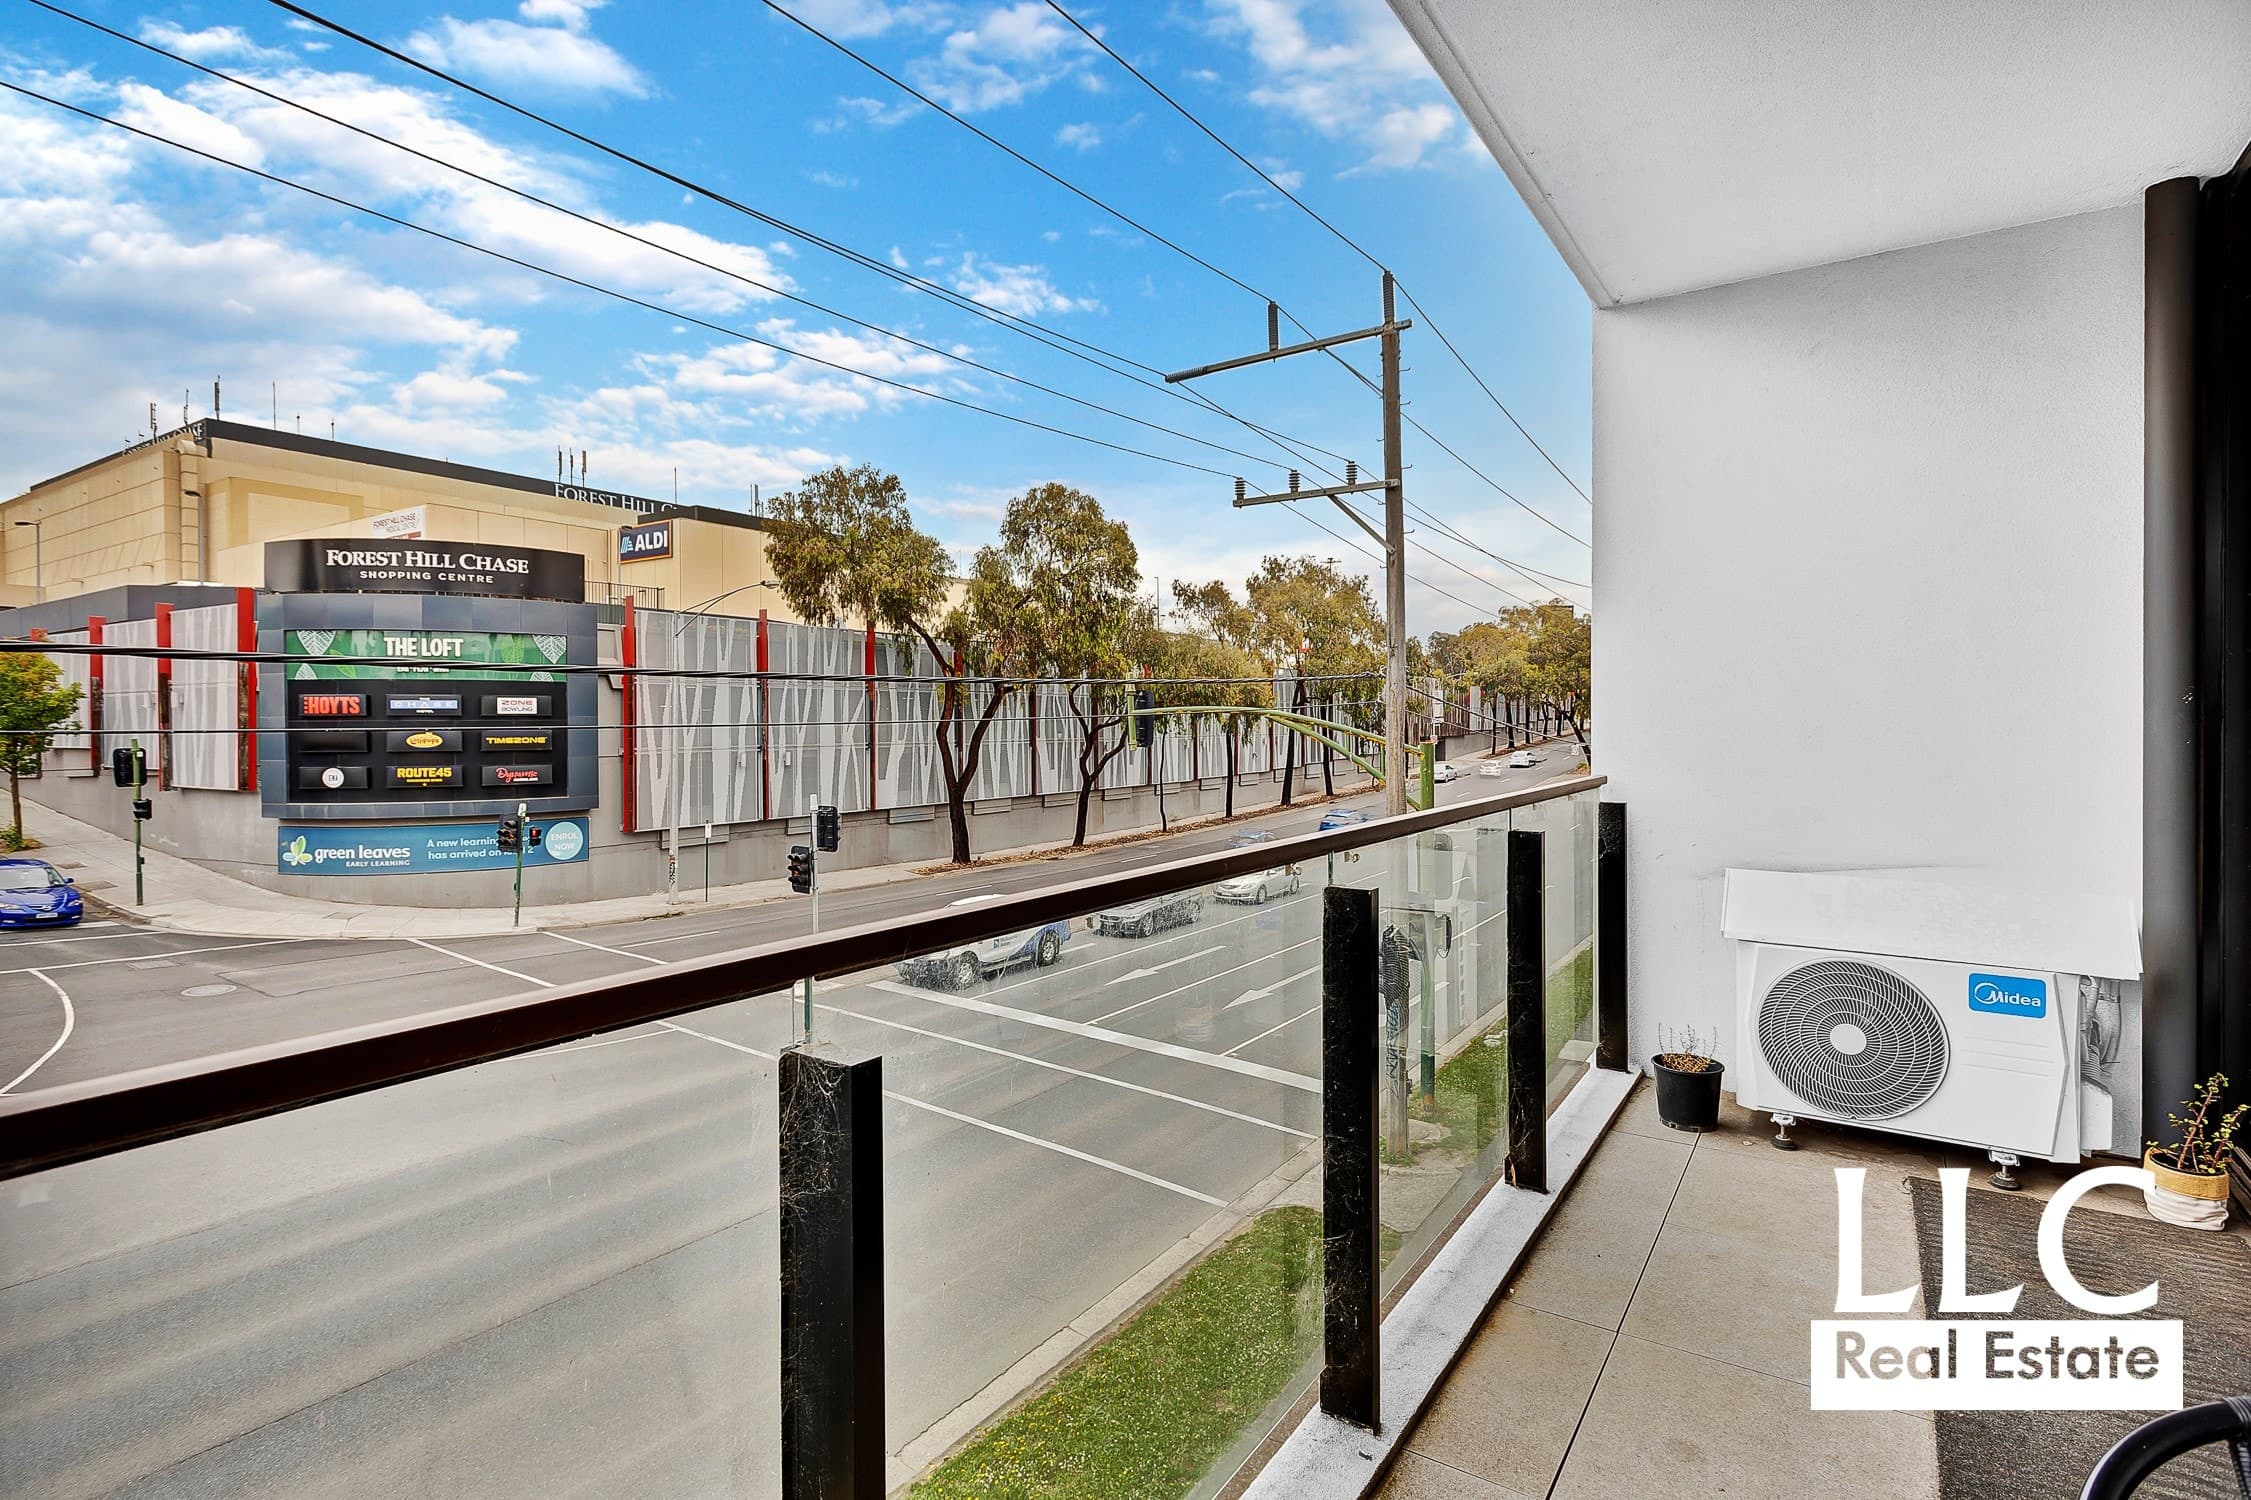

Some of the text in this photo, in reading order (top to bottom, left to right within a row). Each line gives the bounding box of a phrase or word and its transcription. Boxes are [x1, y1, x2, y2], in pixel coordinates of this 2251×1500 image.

[555, 483, 617, 512] FOREST
[635, 530, 668, 552] ALDI
[326, 550, 529, 574] FOREST HILL CHASE
[359, 570, 494, 584] SHOPPING CENTRE
[384, 637, 464, 657] THE LOFT
[307, 696, 360, 715] HOYTS
[485, 736, 546, 745] TIMEZONE
[397, 767, 453, 778] ROUTE45
[426, 839, 435, 848] A
[436, 839, 457, 848] new
[460, 837, 499, 847] learnin
[554, 842, 576, 851] NOW
[314, 844, 411, 864] green leaves
[428, 851, 447, 860] has
[449, 848, 487, 859] arrived
[527, 845, 534, 854] 2
[370, 859, 411, 867] LEARNING
[1977, 984, 2041, 1007] Midea
